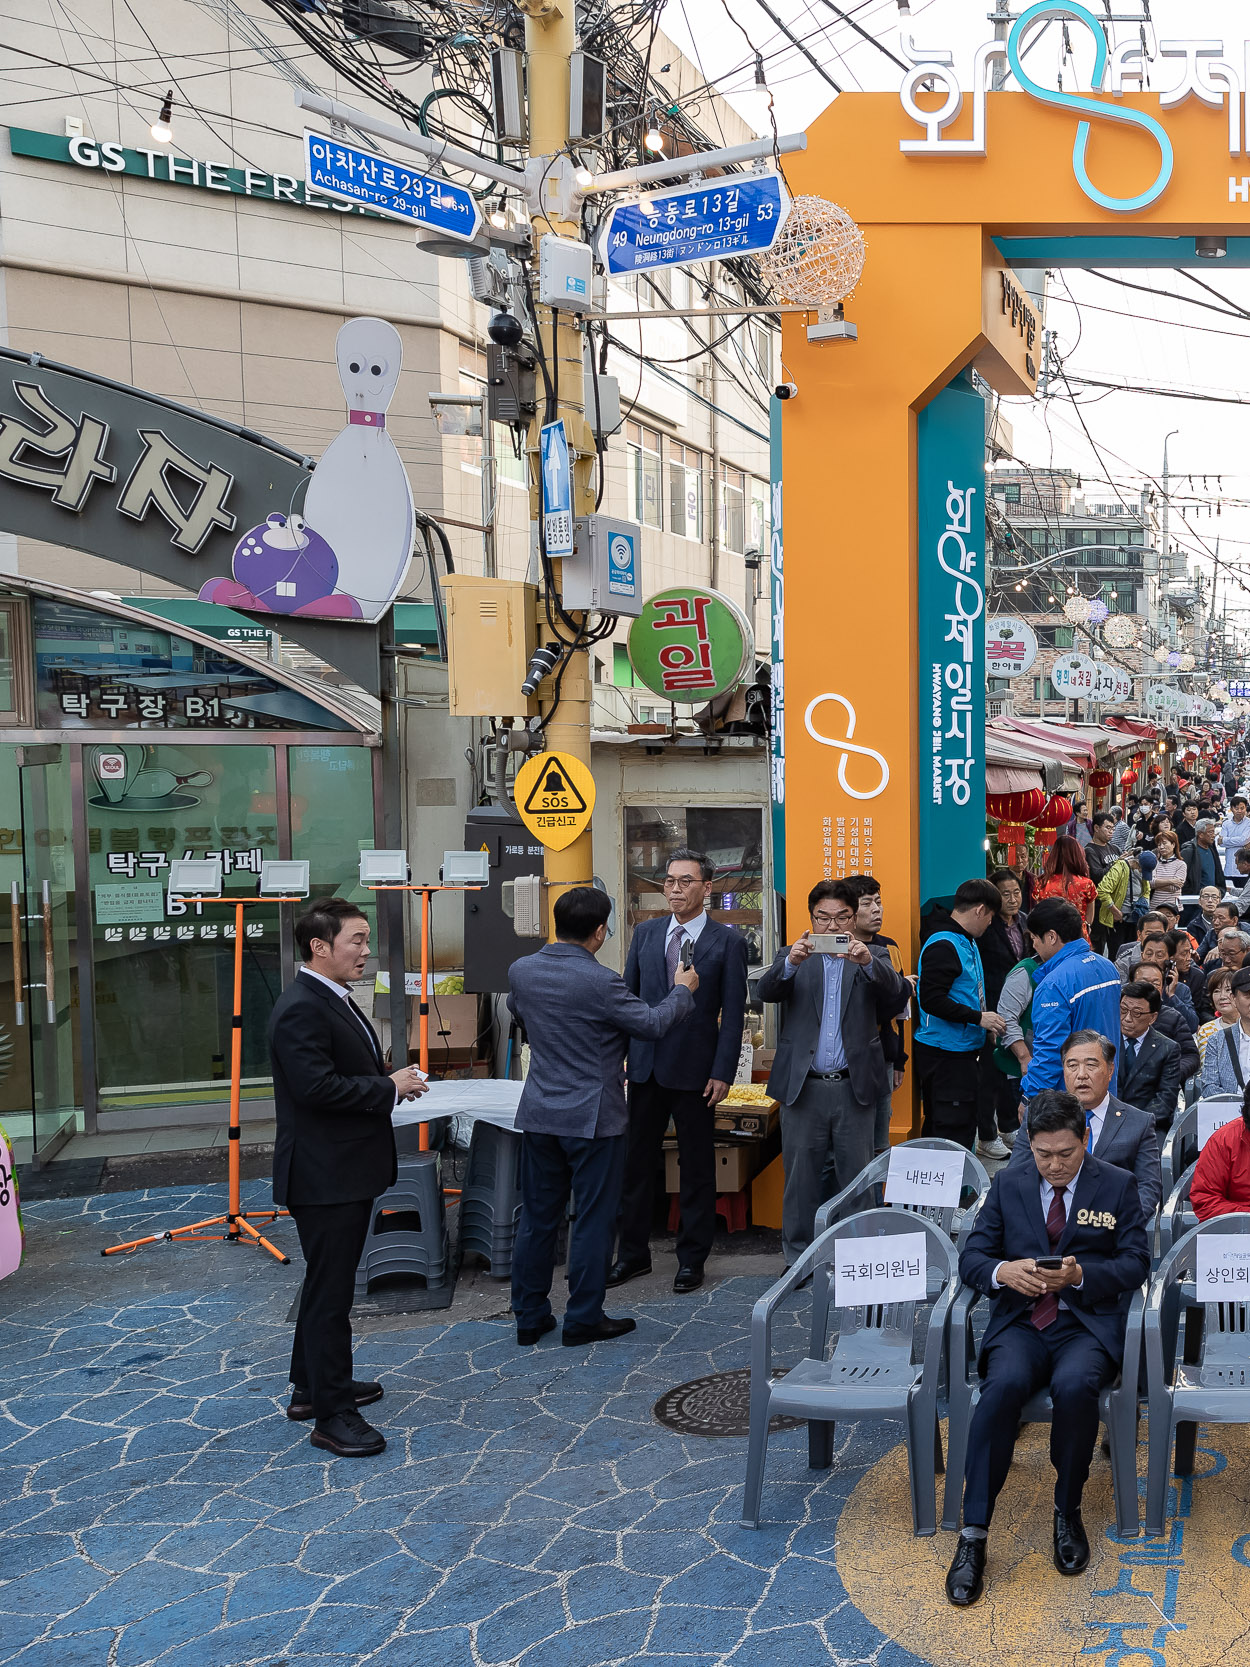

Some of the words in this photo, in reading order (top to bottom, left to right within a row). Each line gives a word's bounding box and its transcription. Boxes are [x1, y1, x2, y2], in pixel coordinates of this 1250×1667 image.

[68, 137, 126, 170] GS
[136, 148, 229, 190] THE
[245, 168, 386, 217] FRE
[311, 142, 442, 210] 아차산로29길
[314, 174, 388, 205] Achasan-ro
[392, 199, 426, 219] 29-gil
[612, 231, 627, 248] 49
[635, 223, 714, 248] Neungdong-ro
[718, 213, 750, 234] 13-gil
[757, 203, 773, 221] 53
[228, 628, 240, 636] GS
[242, 628, 263, 636] THE
[652, 597, 717, 691] 과일
[985, 640, 1027, 661] 꽃
[992, 662, 1022, 671] 한아름
[63, 693, 166, 718] 탁구장
[187, 696, 220, 718] B1
[932, 663, 942, 728] HWAYANG
[932, 730, 942, 752] JEIL
[932, 754, 942, 805] MARKET
[542, 797, 569, 808] SOS
[536, 816, 576, 828] 긴급신고
[505, 846, 524, 855] 가로등
[850, 817, 859, 867] 기성세대와
[863, 817, 873, 867] 뫼비우스의
[108, 852, 169, 877] 탁구
[166, 893, 203, 916] B1
[906, 1169, 945, 1186] 내빈석
[1077, 1208, 1117, 1230] 오신환
[841, 1258, 920, 1282] 국회의원님
